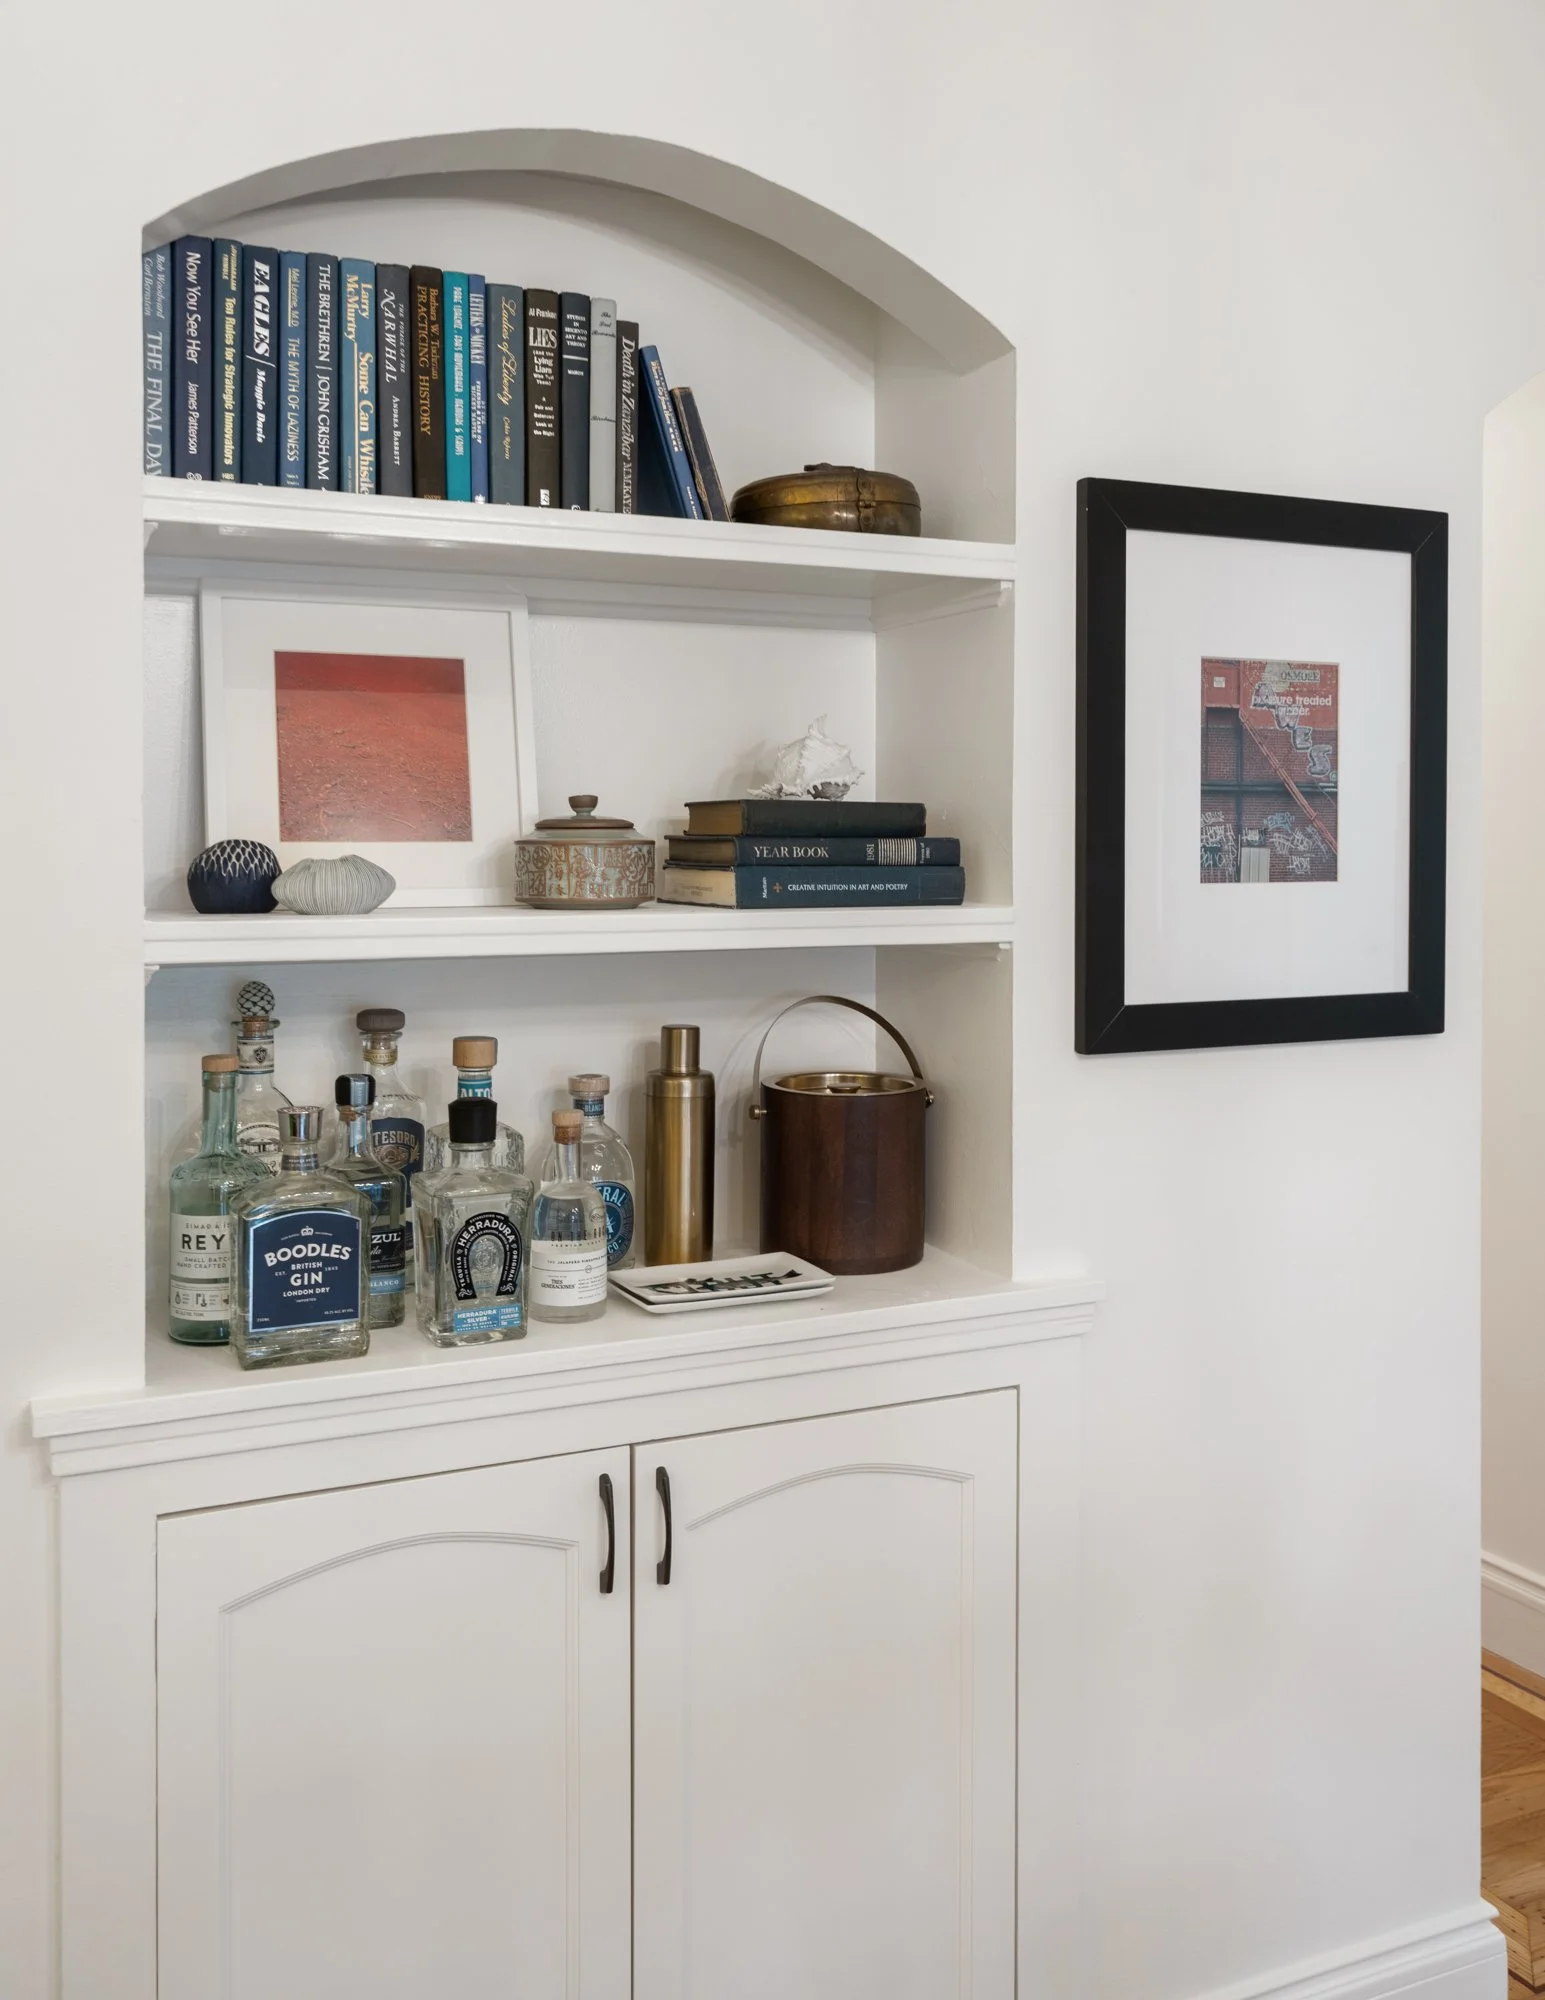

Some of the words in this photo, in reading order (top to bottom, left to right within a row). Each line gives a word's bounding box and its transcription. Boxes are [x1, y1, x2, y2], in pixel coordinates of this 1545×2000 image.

[144, 258, 153, 276] Carl
[156, 254, 165, 271] Bob
[186, 252, 201, 282] Now
[291, 268, 299, 282] Mel
[319, 264, 330, 290] THE
[144, 278, 153, 315] Bernstein
[156, 273, 165, 318] Woodward
[186, 286, 201, 310] You
[225, 297, 236, 314] Ten
[253, 260, 270, 357] EAGLES
[344, 274, 358, 343] McMurtry
[358, 283, 373, 319] Larry
[430, 288, 439, 320] Barbara
[470, 293, 484, 327] LETTERS
[187, 313, 201, 336] See
[291, 310, 299, 327] M.D.
[417, 285, 429, 367] PRACTICING
[501, 296, 516, 340] Ladies
[529, 307, 535, 316] Al
[225, 317, 236, 345] Rules
[319, 293, 330, 361] BRETHREN
[381, 289, 397, 383] NARWHAL
[431, 324, 439, 336] W.
[528, 327, 557, 349] LIES
[147, 332, 163, 371] THE
[187, 340, 201, 363] Her
[225, 348, 236, 362] for
[288, 338, 299, 357] THE
[431, 340, 439, 379] Tuchman
[471, 334, 485, 366] MICKEY
[498, 342, 516, 356] of
[534, 356, 553, 367] Lying
[622, 336, 635, 377] Death
[288, 361, 299, 392] MYTH
[358, 352, 373, 394] Some
[497, 356, 516, 406] Liberty
[535, 365, 552, 374] Liars
[188, 381, 199, 410] James
[222, 364, 236, 409] Strategic
[255, 368, 266, 410] Maggie
[317, 374, 329, 413] JOHN
[622, 379, 634, 394] in
[146, 377, 162, 435] FINAL
[288, 395, 299, 409] OF
[359, 400, 374, 432] Can
[392, 396, 400, 428] ANDREA
[419, 375, 431, 435] HISTORY
[188, 411, 199, 454] Patterson
[224, 412, 235, 465] Innovators
[256, 411, 265, 443] Davis
[288, 412, 299, 461] LAZINESS
[622, 394, 635, 460] Zanzibar
[318, 415, 329, 480] GRISHAM
[393, 430, 401, 466] BARRETT
[359, 439, 374, 495] Whistle
[1296, 694, 1331, 706] treated
[754, 846, 790, 858] YEAR
[793, 846, 829, 858] BOOK
[866, 844, 875, 861] 1981
[373, 1131, 416, 1146] TESORO
[182, 1234, 225, 1250] REY
[372, 1233, 401, 1243] ZUL
[458, 1219, 515, 1247] HERRADURA
[264, 1243, 352, 1267] BOODLES
[291, 1262, 322, 1270] BRITISH
[508, 1250, 518, 1282] ORIGINAL
[290, 1271, 322, 1286] GIN
[456, 1257, 465, 1287] TEQUILA
[283, 1289, 313, 1297] LONDON
[458, 1310, 496, 1319] HERRADURA
